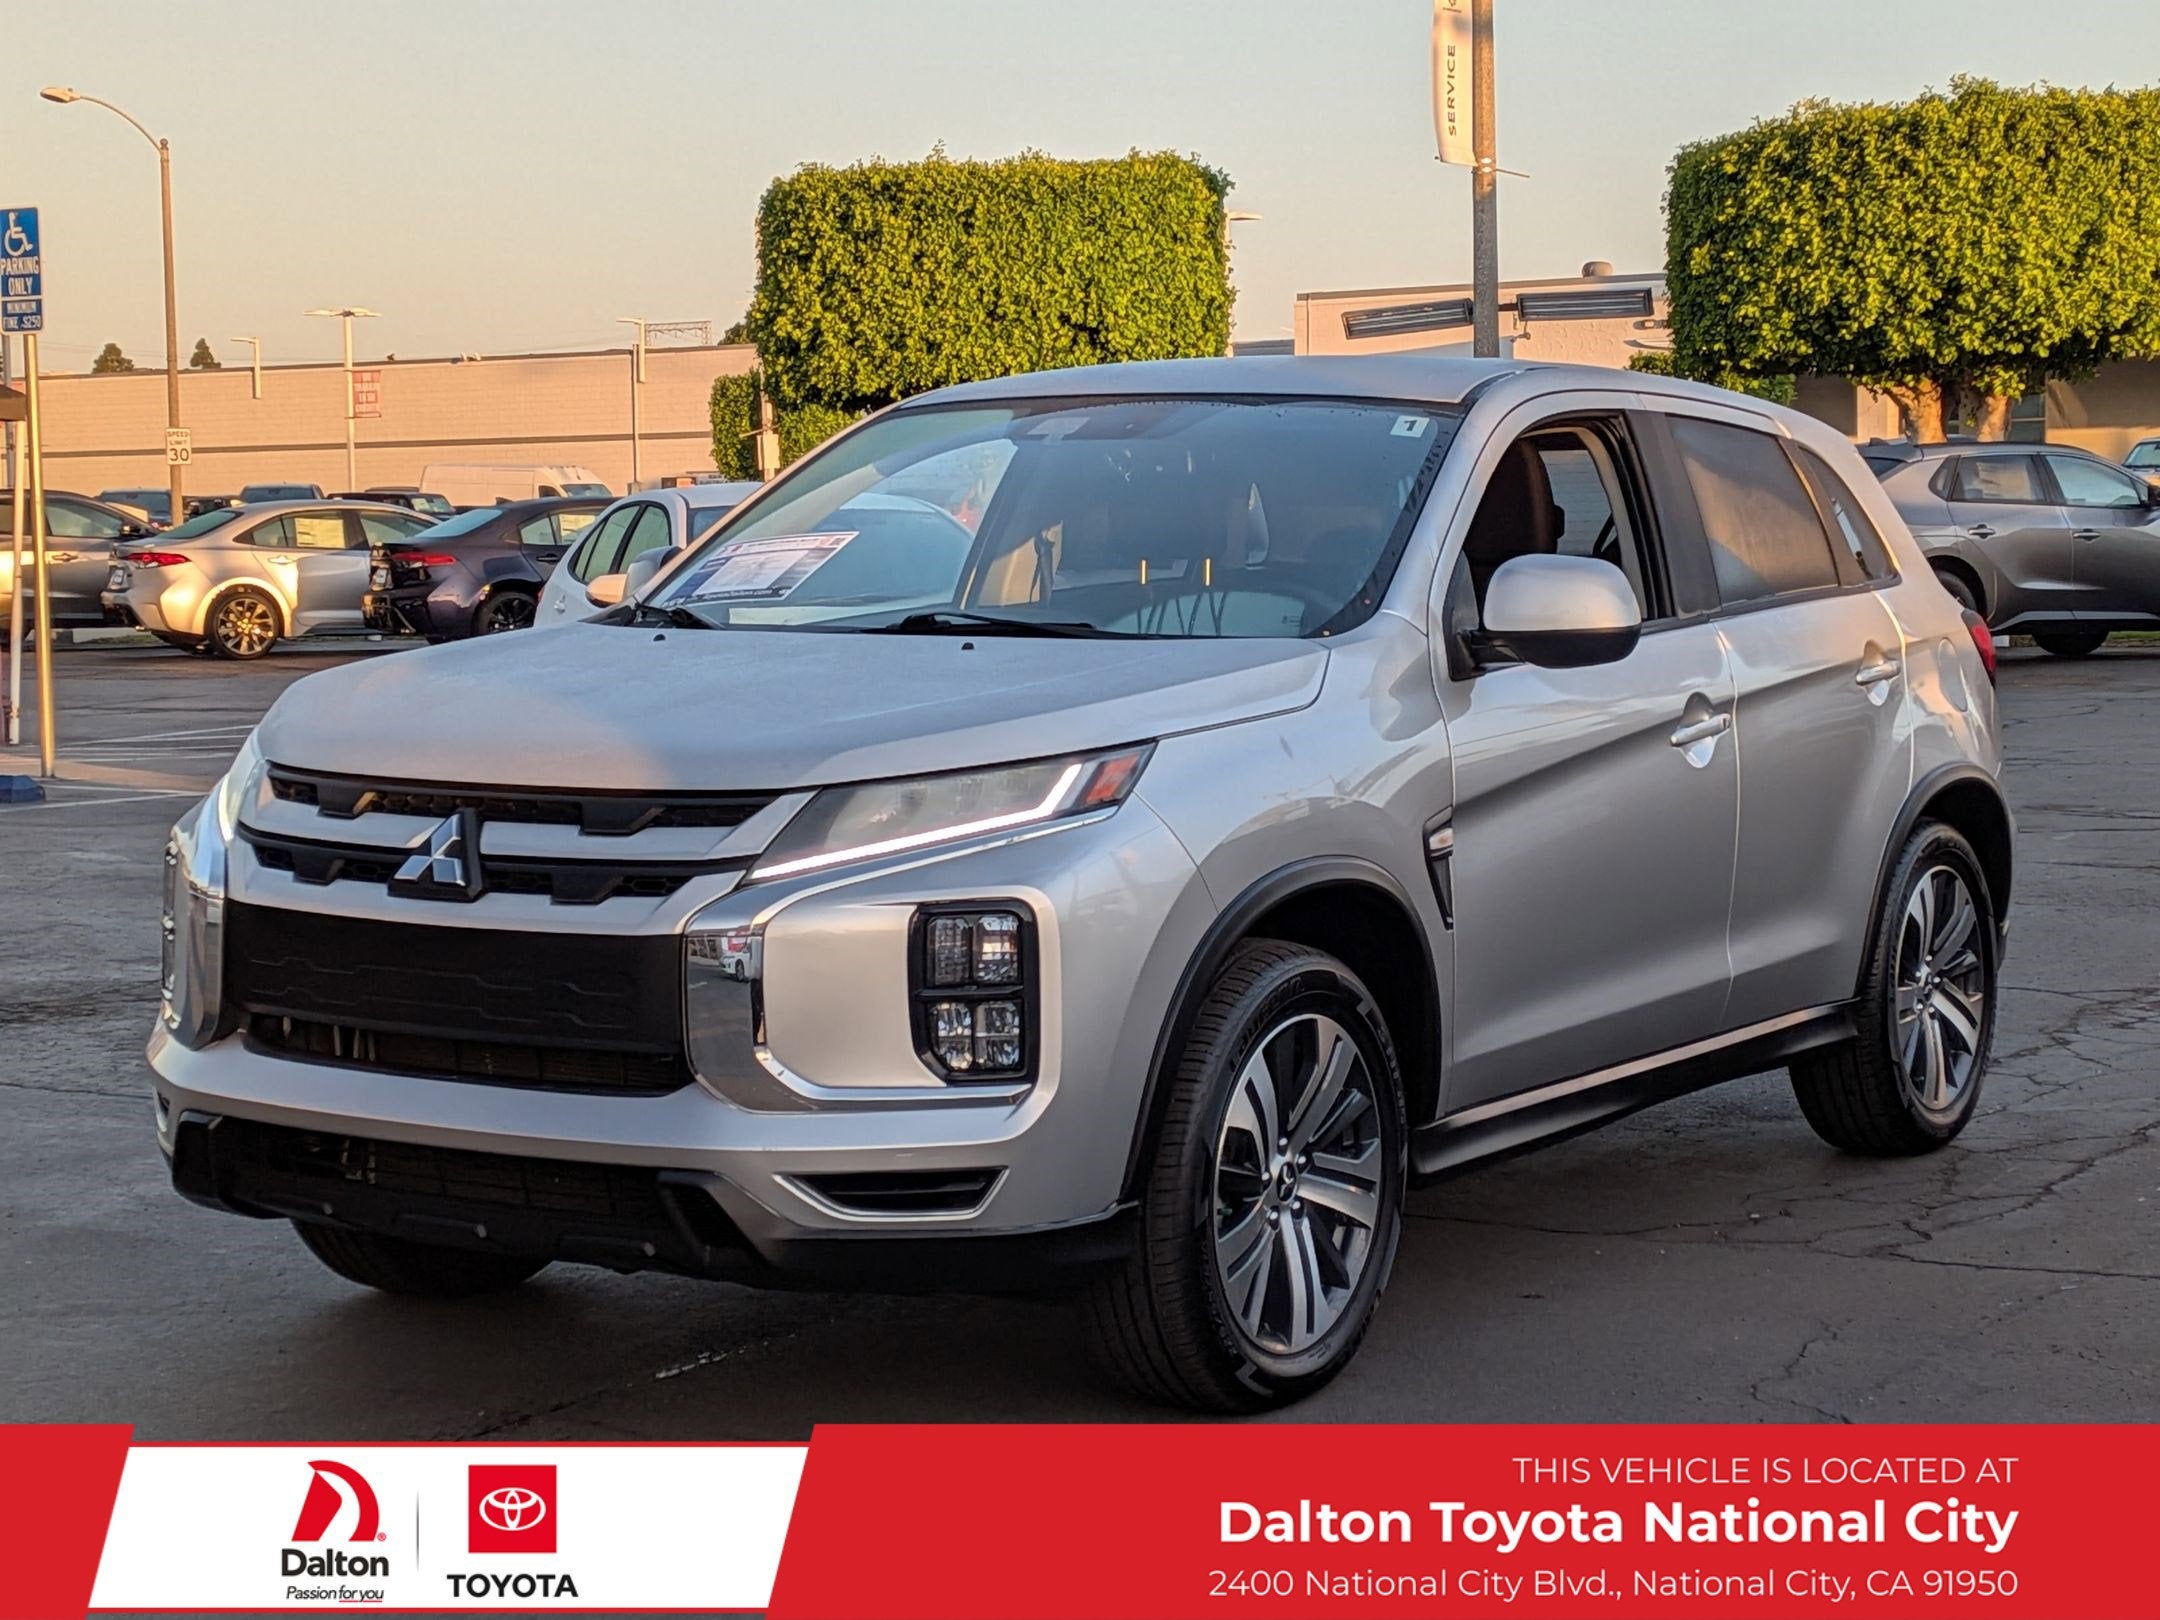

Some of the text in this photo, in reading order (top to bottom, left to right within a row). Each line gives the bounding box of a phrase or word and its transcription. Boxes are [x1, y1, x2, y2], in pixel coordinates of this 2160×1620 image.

[1446, 44, 1457, 137] SERVICE
[0, 256, 39, 276] PARKING
[8, 276, 33, 296] ONLY
[169, 447, 190, 462] 30
